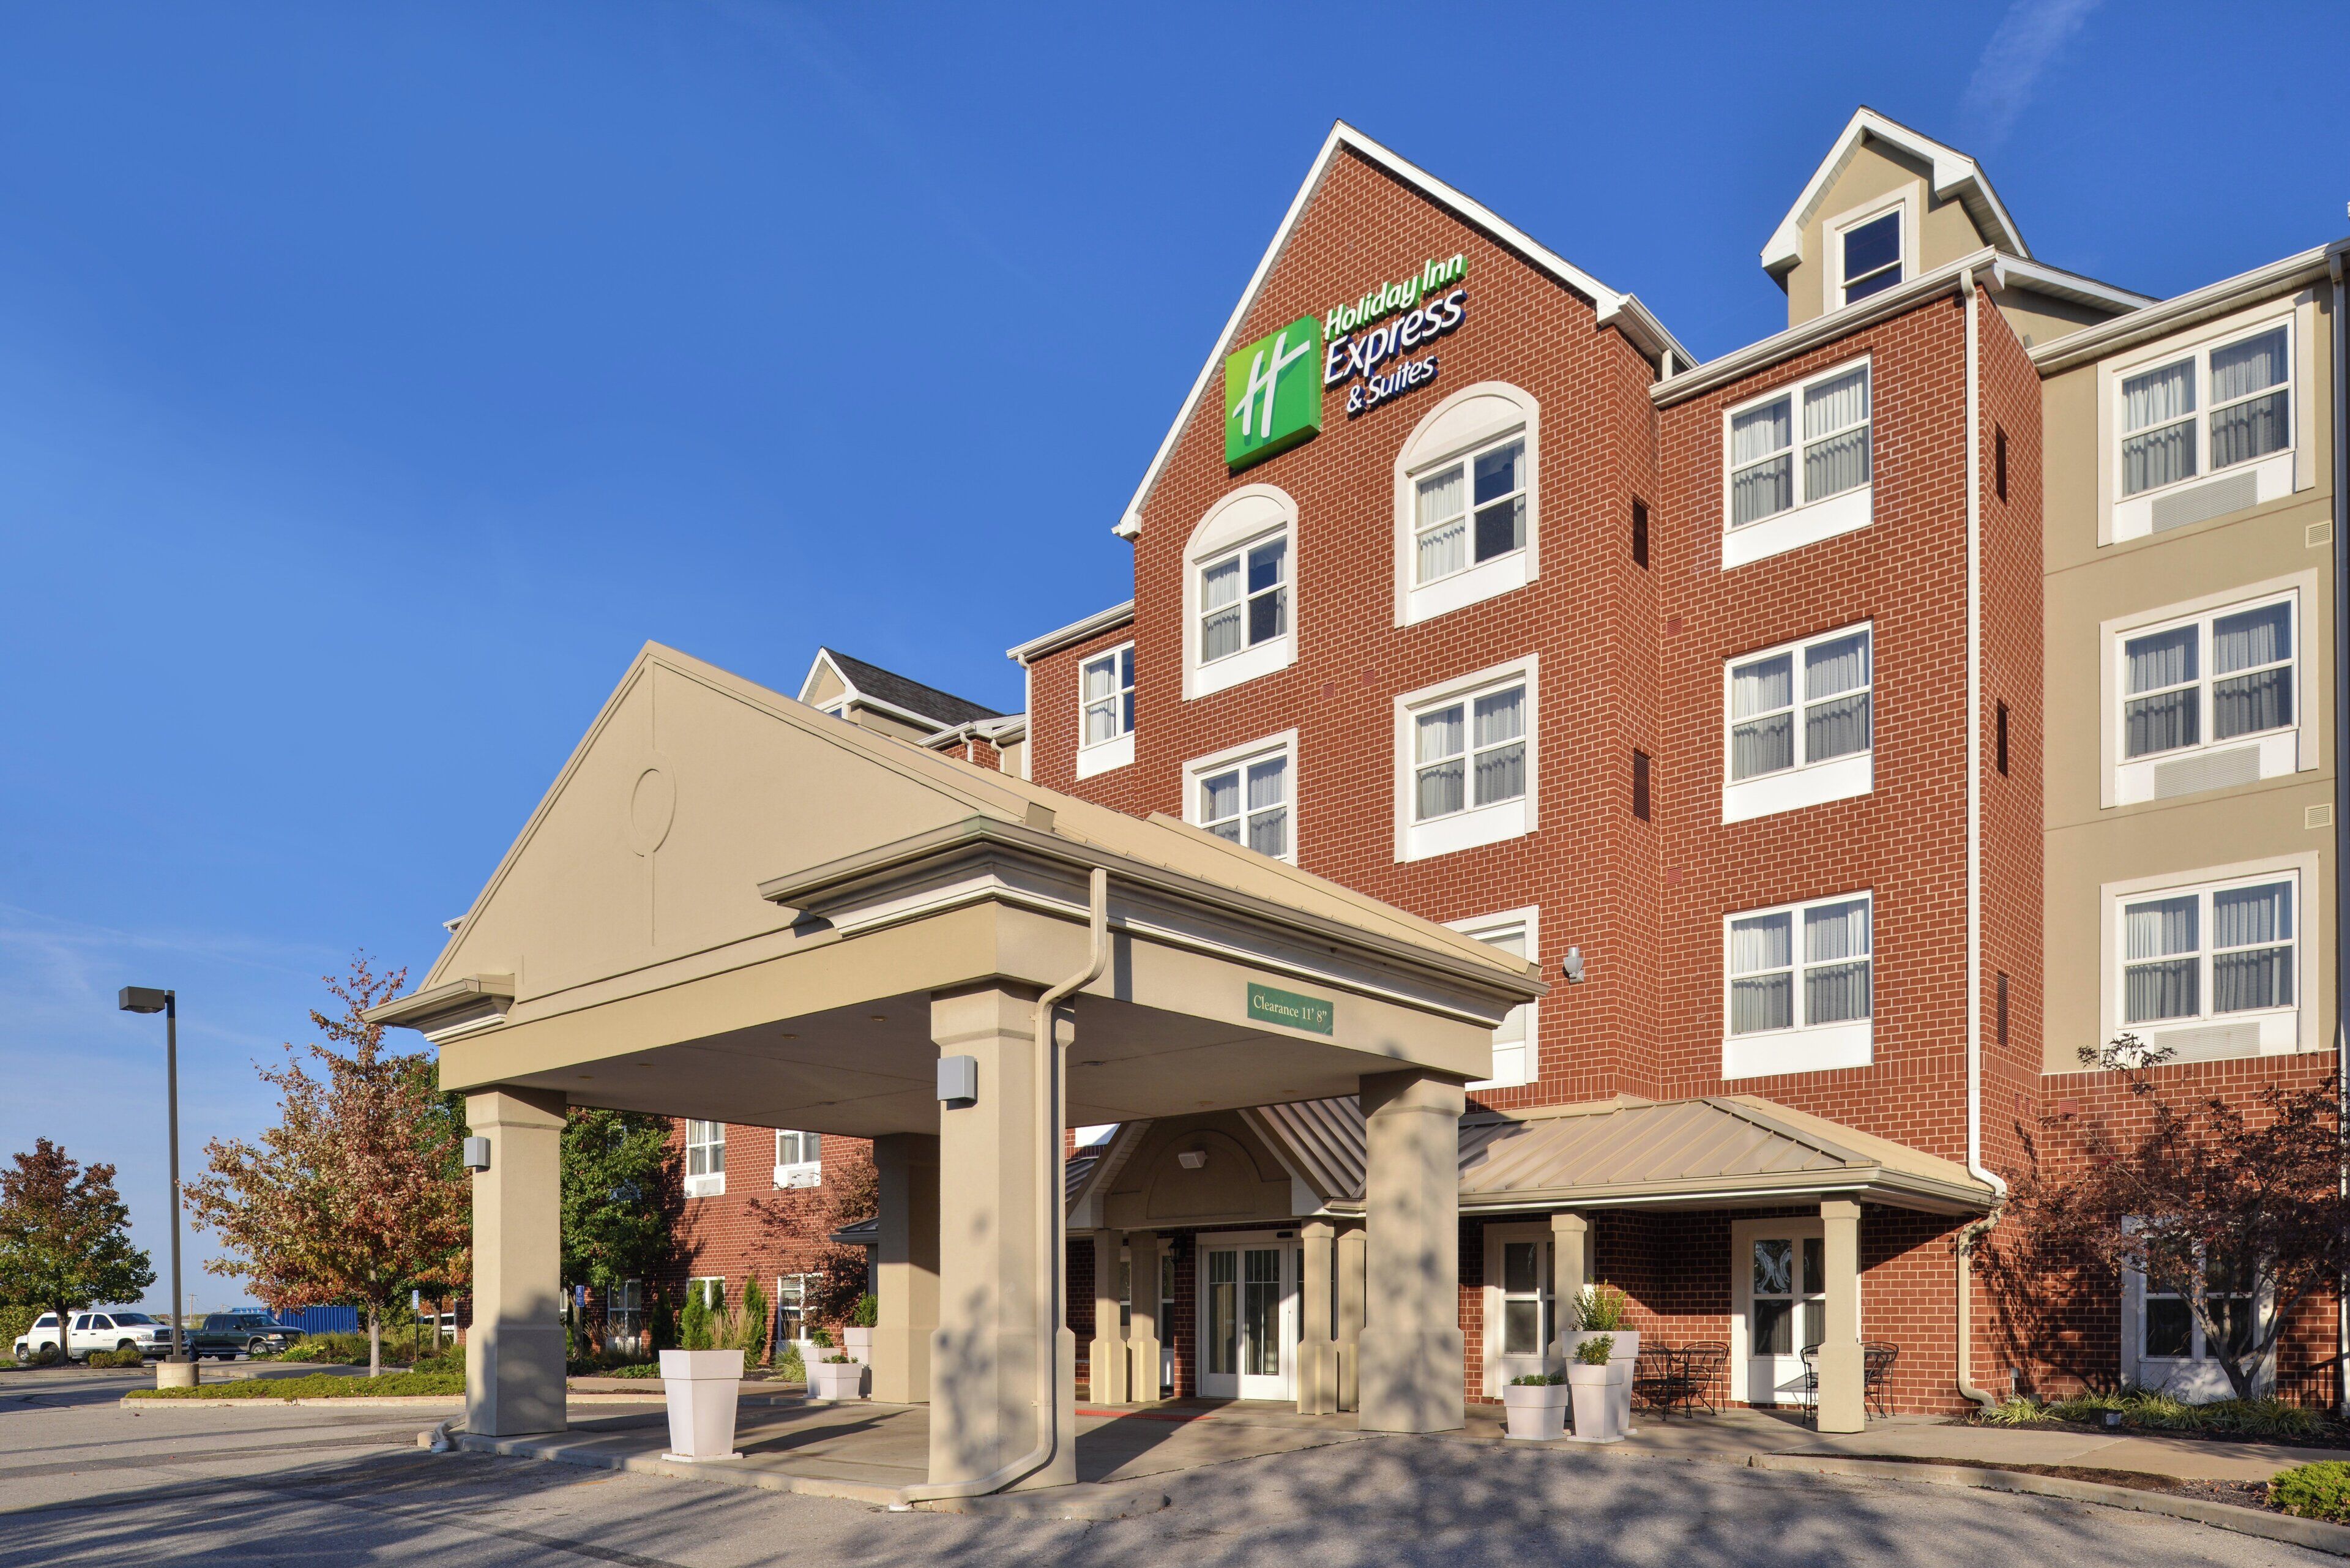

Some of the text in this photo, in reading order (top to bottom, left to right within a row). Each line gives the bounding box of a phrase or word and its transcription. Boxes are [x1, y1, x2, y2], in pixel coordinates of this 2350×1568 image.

[1323, 253, 1466, 341] Holiday Inn
[1324, 289, 1465, 385] Express
[1346, 355, 1436, 413] & Suites
[1253, 995, 1327, 1023] Clearance 11' 8"
